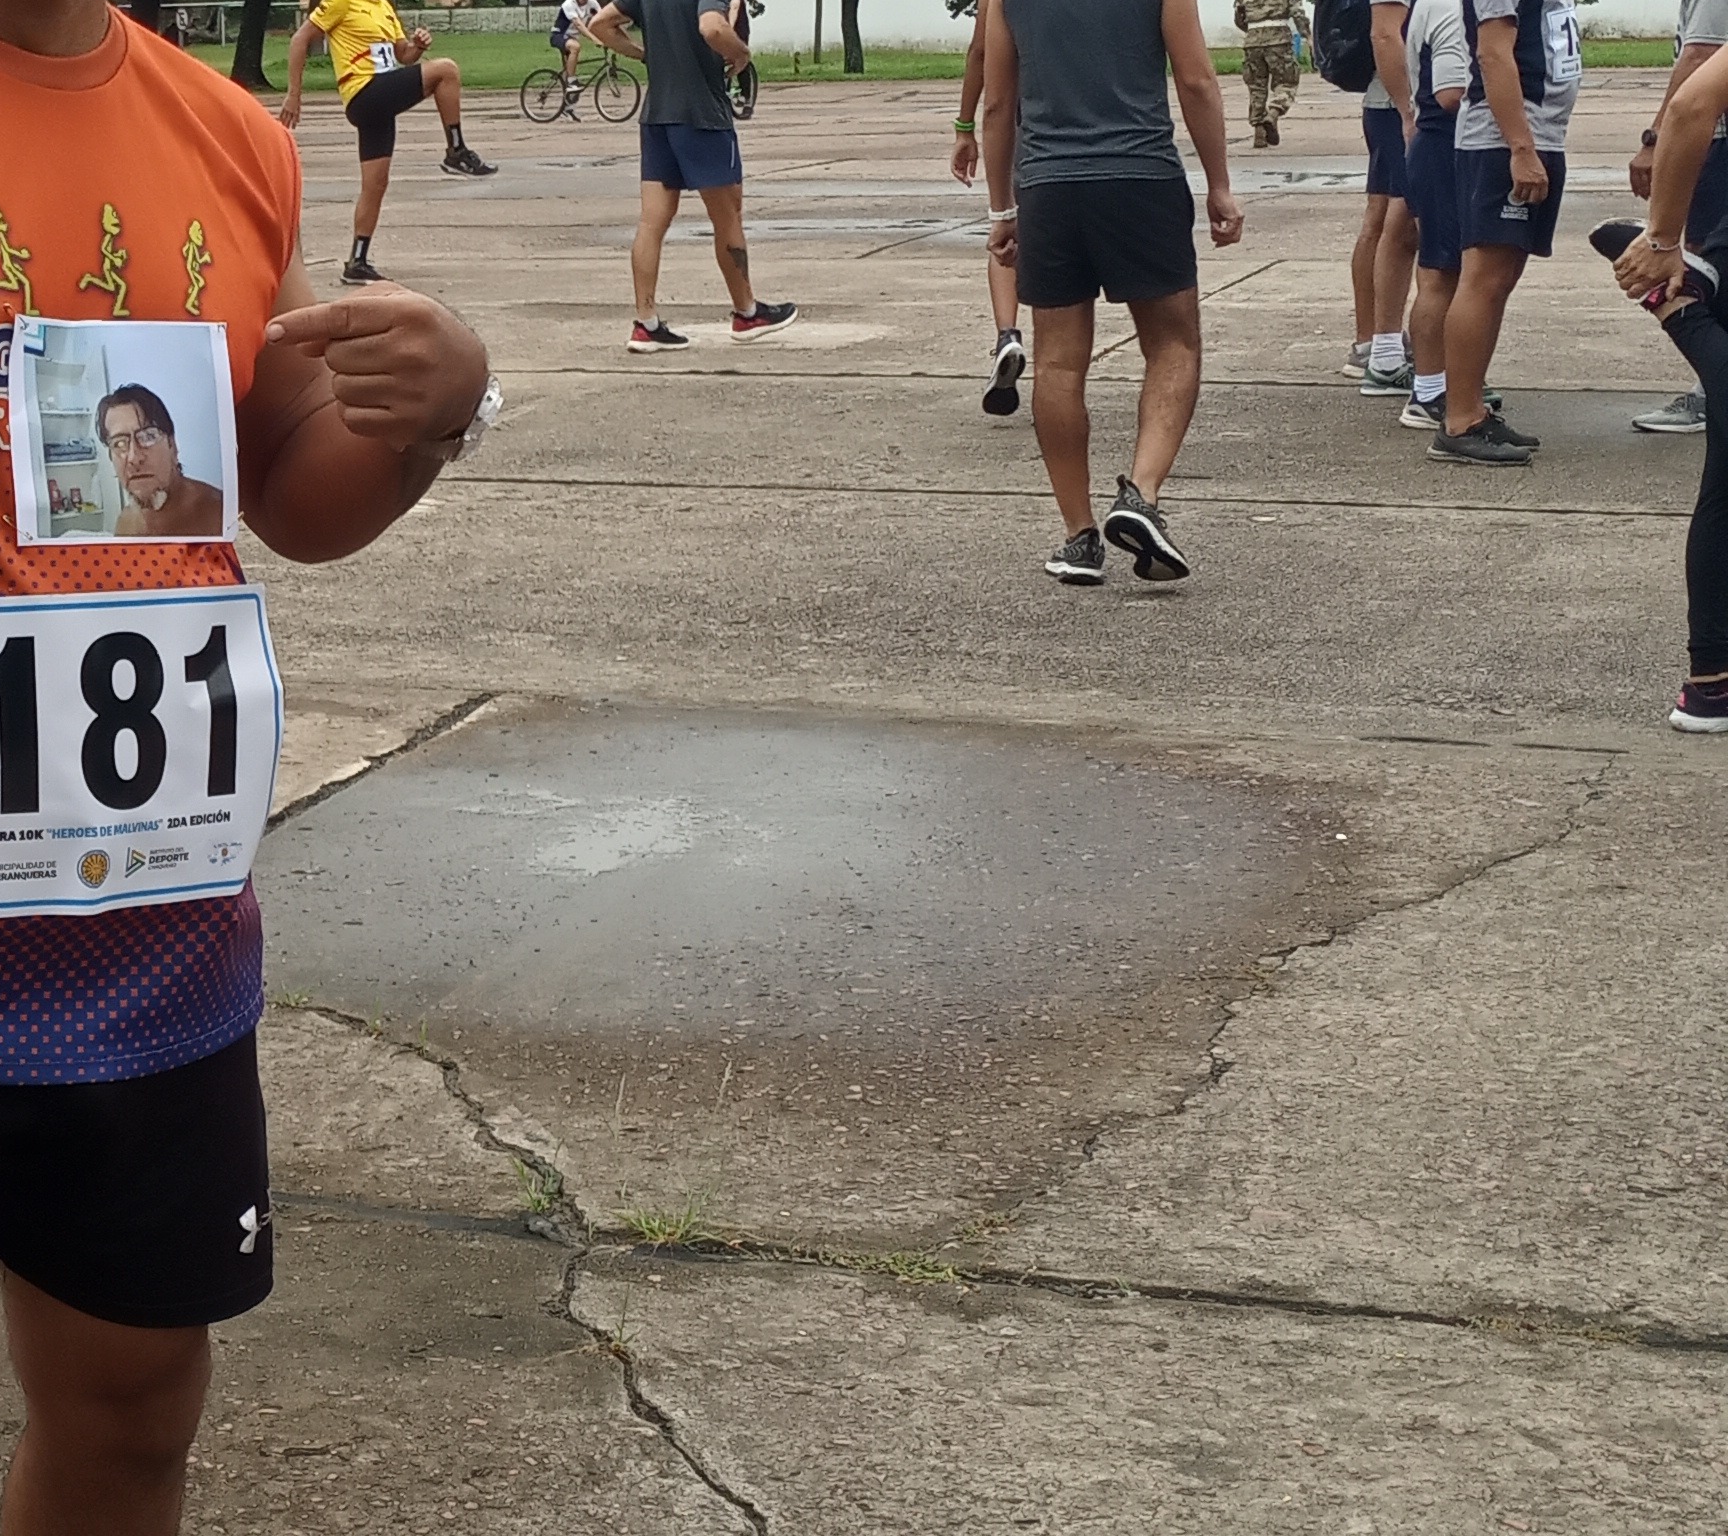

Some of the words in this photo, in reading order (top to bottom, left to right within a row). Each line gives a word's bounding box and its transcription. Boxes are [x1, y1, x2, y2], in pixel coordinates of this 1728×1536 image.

[18, 829, 44, 840] 10K
[100, 824, 113, 837] DE
[167, 817, 188, 829] 2DA
[189, 809, 231, 825] EDICIÓN
[46, 860, 57, 869] DE
[148, 852, 189, 865] DEPORTE
